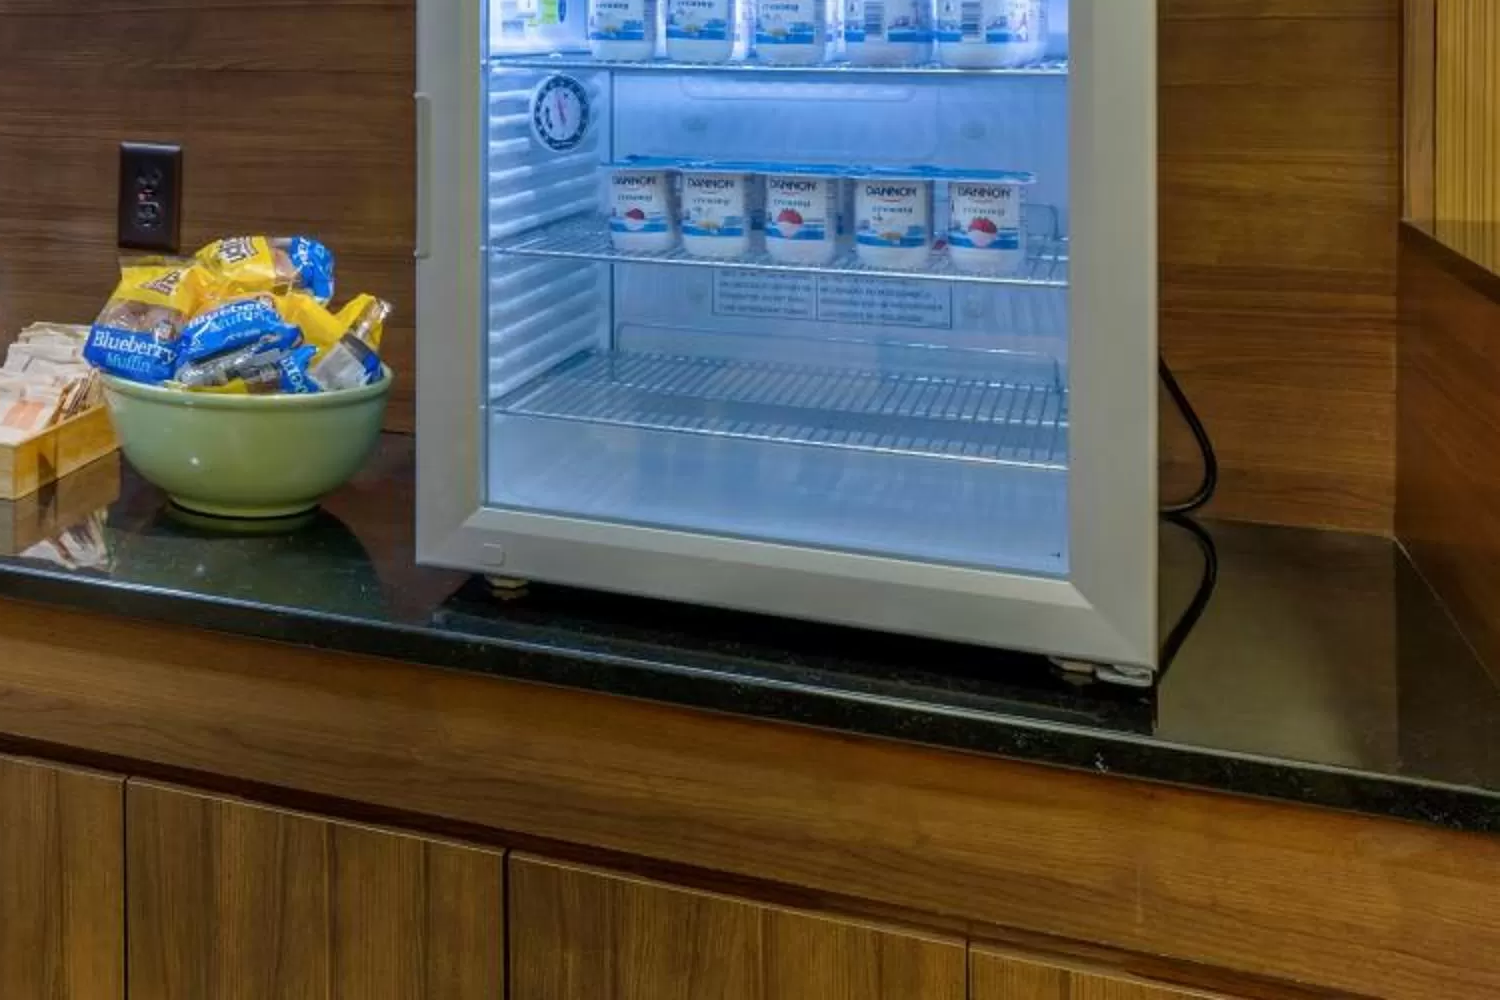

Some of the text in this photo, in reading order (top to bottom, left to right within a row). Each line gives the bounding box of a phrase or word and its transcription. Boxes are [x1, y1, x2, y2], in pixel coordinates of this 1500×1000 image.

[612, 176, 656, 185] DANNON
[687, 178, 735, 189] DANNON
[770, 179, 818, 191] DANNON
[865, 185, 917, 197] DANNON
[957, 187, 1011, 199] DANNON
[92, 331, 176, 365] Blueberry
